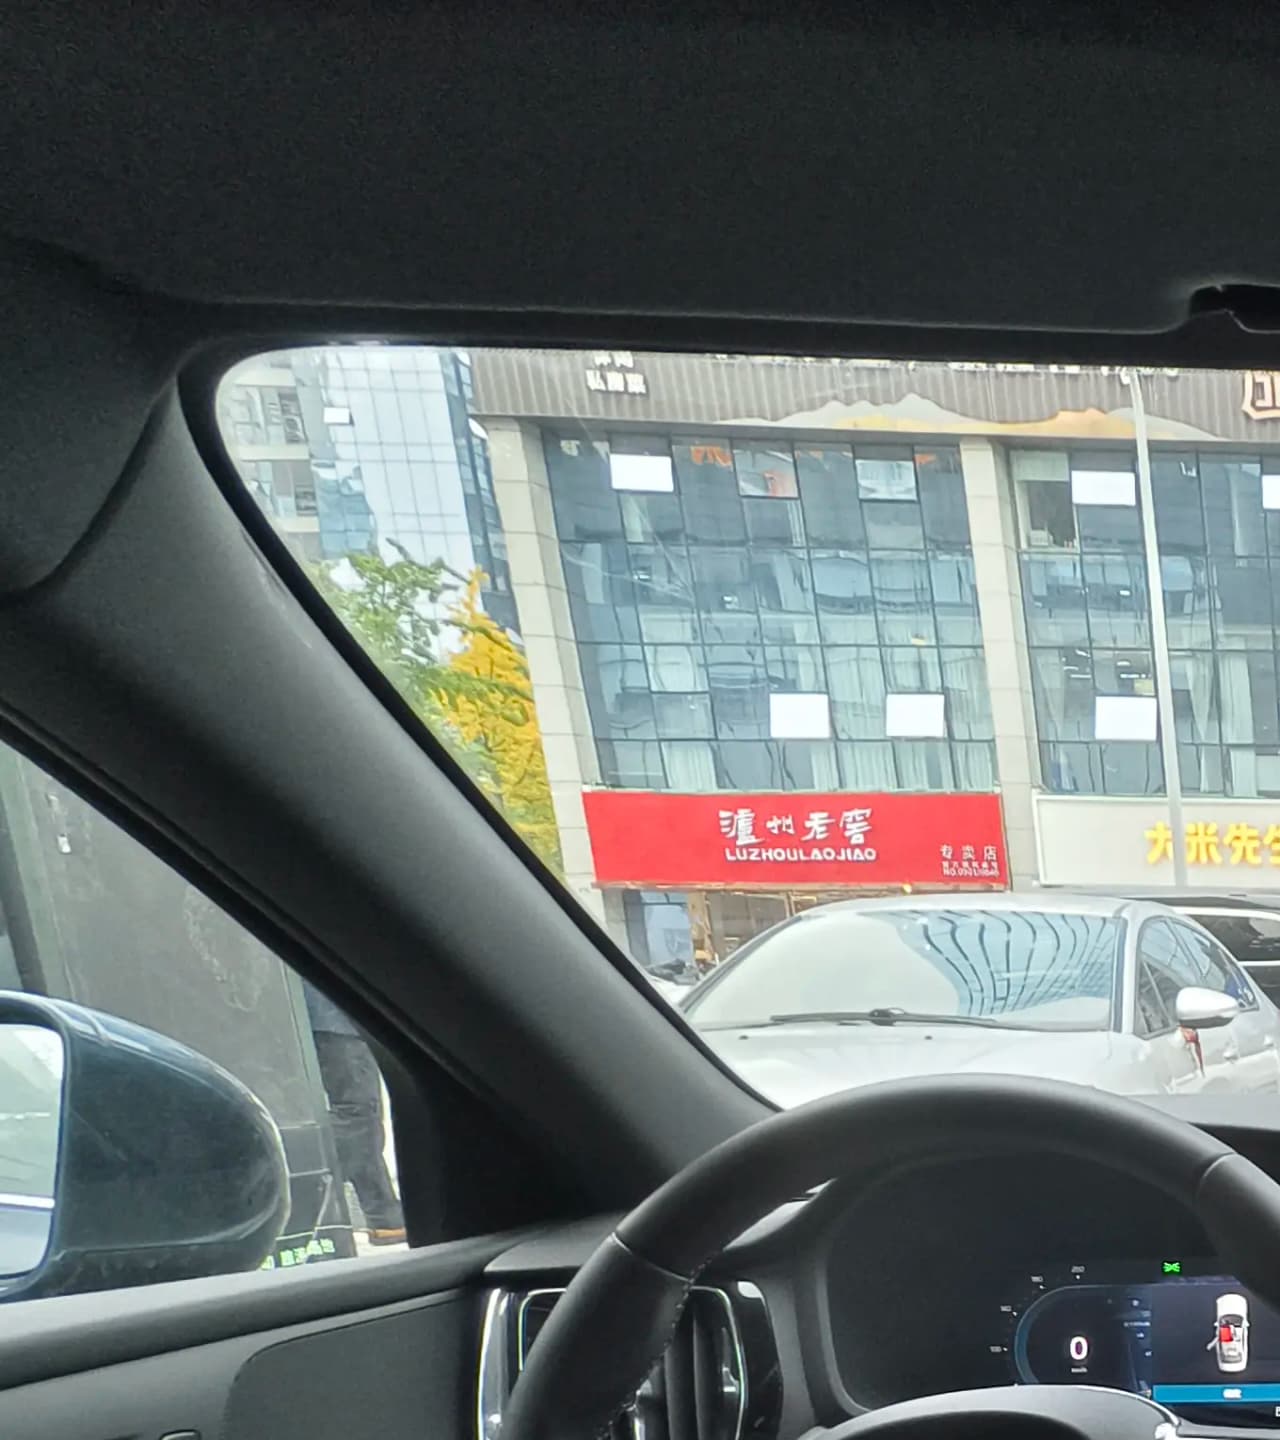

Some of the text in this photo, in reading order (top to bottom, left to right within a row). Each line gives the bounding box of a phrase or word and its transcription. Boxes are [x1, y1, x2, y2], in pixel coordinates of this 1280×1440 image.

[718, 808, 872, 846] 泸州老窖
[724, 847, 877, 862] LUZHOULAOJIAO
[1069, 1335, 1089, 1361] 0
